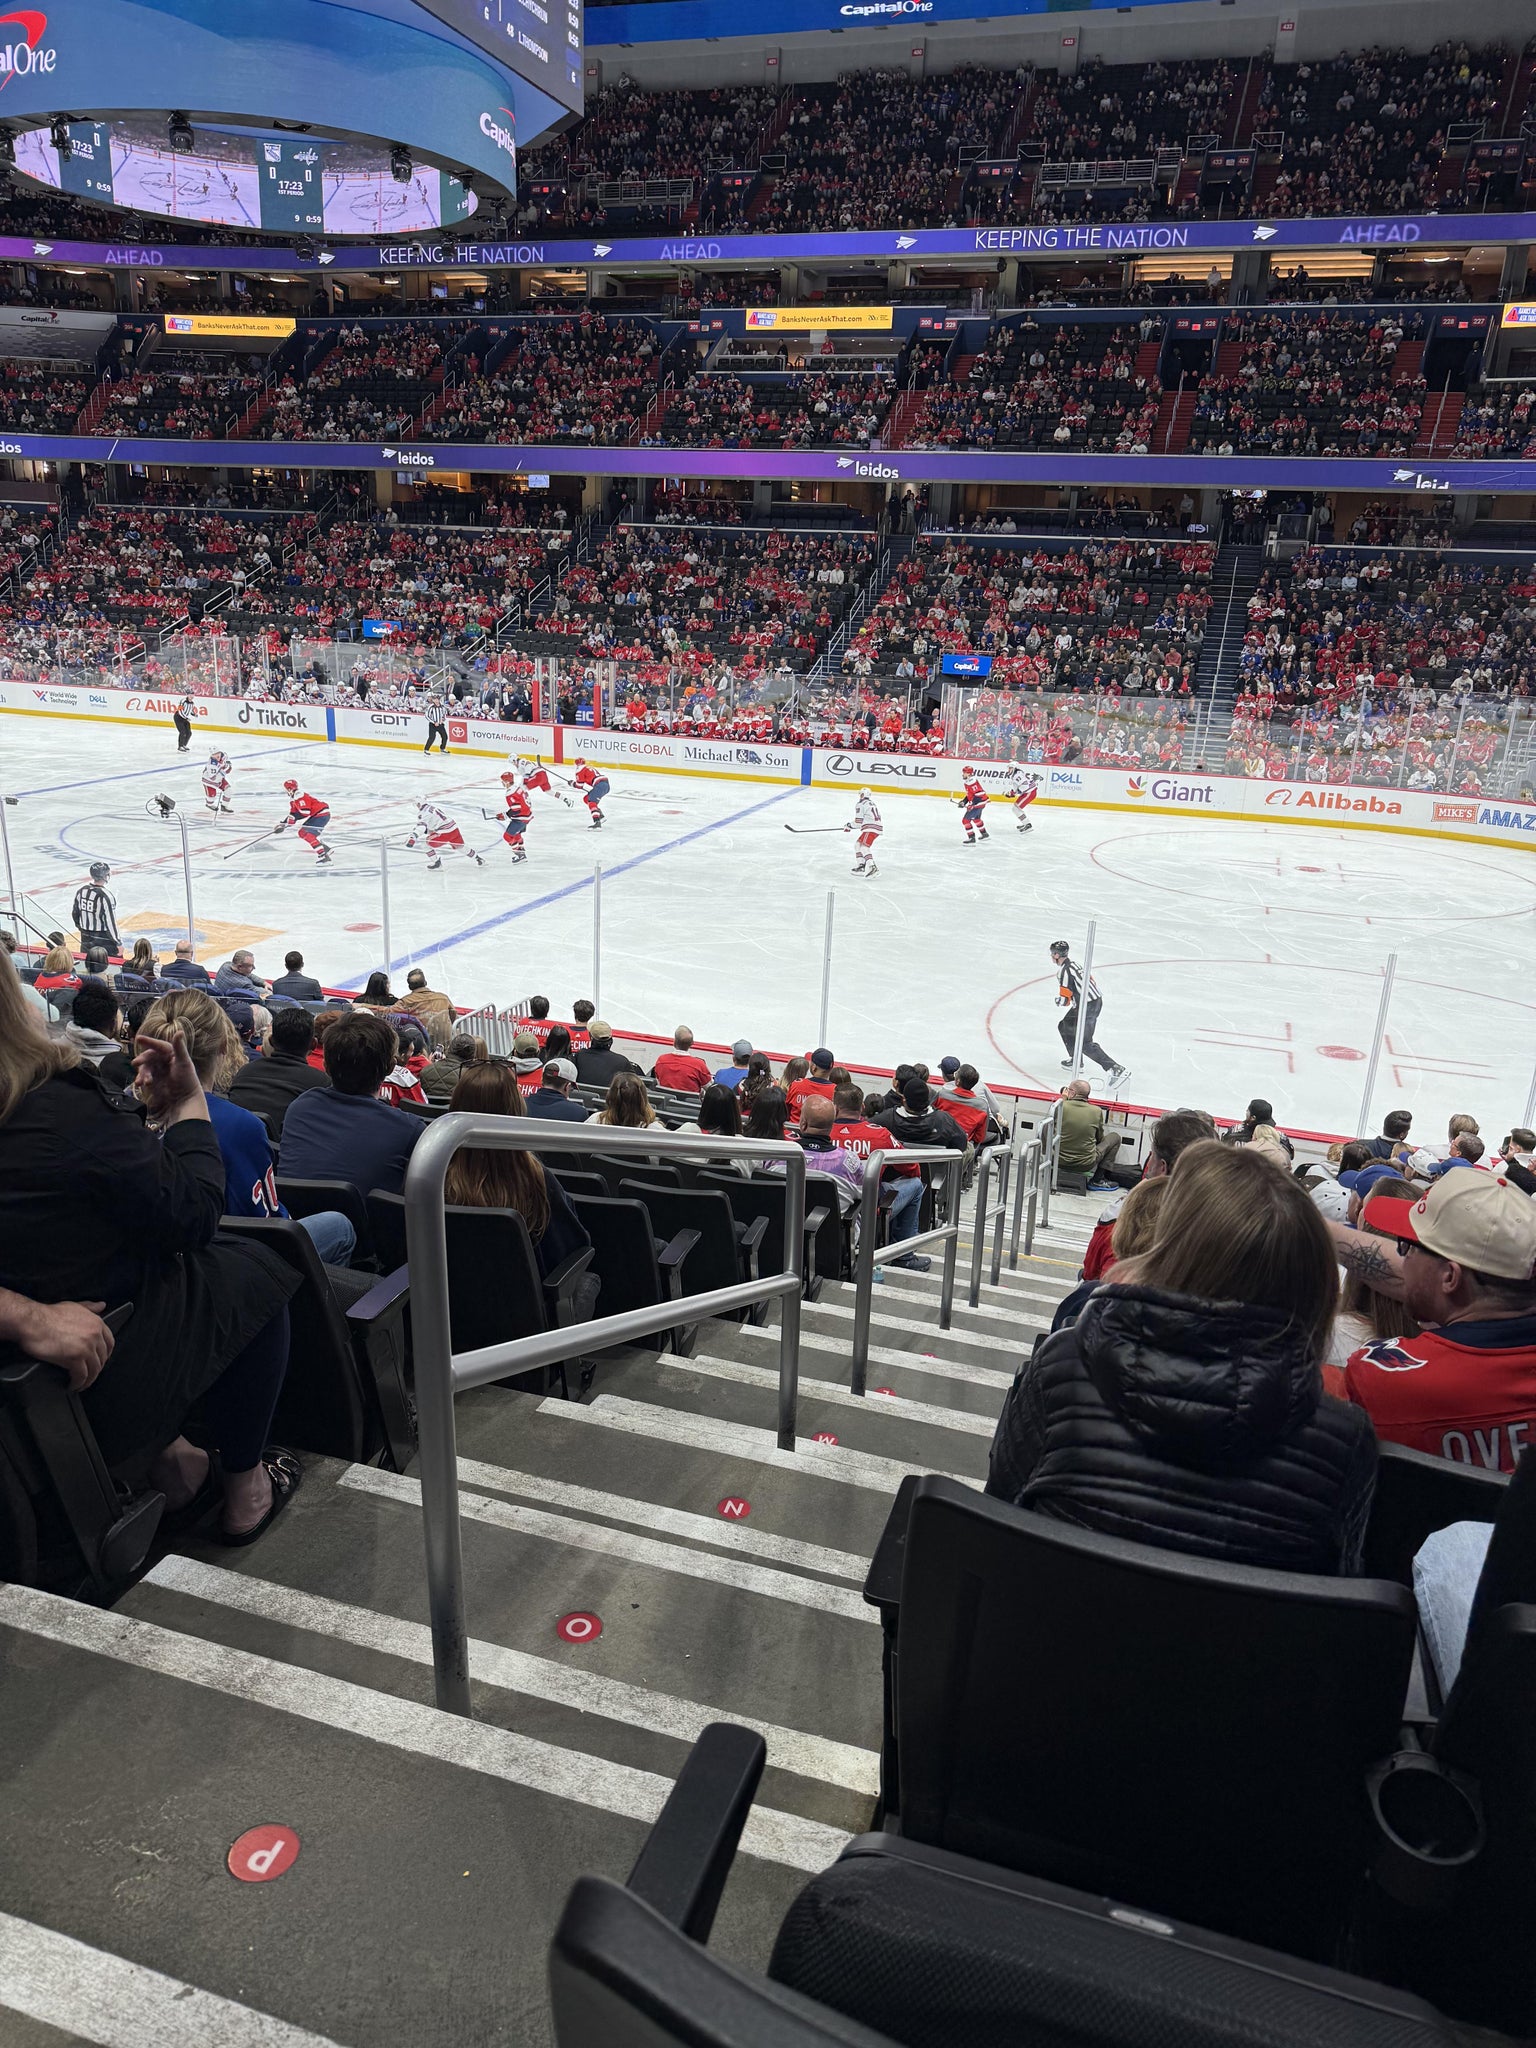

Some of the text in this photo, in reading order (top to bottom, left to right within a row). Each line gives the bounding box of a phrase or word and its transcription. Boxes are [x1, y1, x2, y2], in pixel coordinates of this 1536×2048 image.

[71, 139, 93, 154] 17:23
[269, 166, 312, 182] 0 0
[86, 179, 111, 192] 9 0:59
[278, 180, 303, 190] 17:23
[294, 214, 321, 223] 9 0:59
[975, 228, 1189, 249] KEEPING THE NATION
[1339, 223, 1420, 243] AHEAD
[105, 249, 163, 266] AHEAD
[482, 246, 544, 264] NATION
[660, 243, 721, 260] AHEAD
[197, 321, 270, 331] BanksNeverAskThat.com
[781, 314, 863, 324] BanksNeverAskThat.com
[398, 450, 433, 465] leidos
[855, 461, 899, 479] leidos
[50, 697, 77, 706] Technology
[89, 695, 107, 704] DELL
[144, 699, 208, 717] Aliba
[257, 709, 307, 728] TikTok
[370, 714, 412, 727] GDIT
[472, 730, 539, 745] TOYOTAffordability
[575, 738, 674, 757] VENTURE GLOBAL
[684, 745, 732, 762] Michael
[764, 752, 790, 767] Son
[857, 762, 937, 779] LEXUS
[1051, 772, 1082, 784] DELL
[1152, 779, 1213, 803] Giant
[1296, 790, 1402, 816] Alibaba
[1438, 808, 1472, 818] MIKE'S
[81, 899, 93, 912] 68
[723, 1500, 746, 1517] N
[565, 1616, 593, 1639] O
[247, 1840, 285, 1874] P
